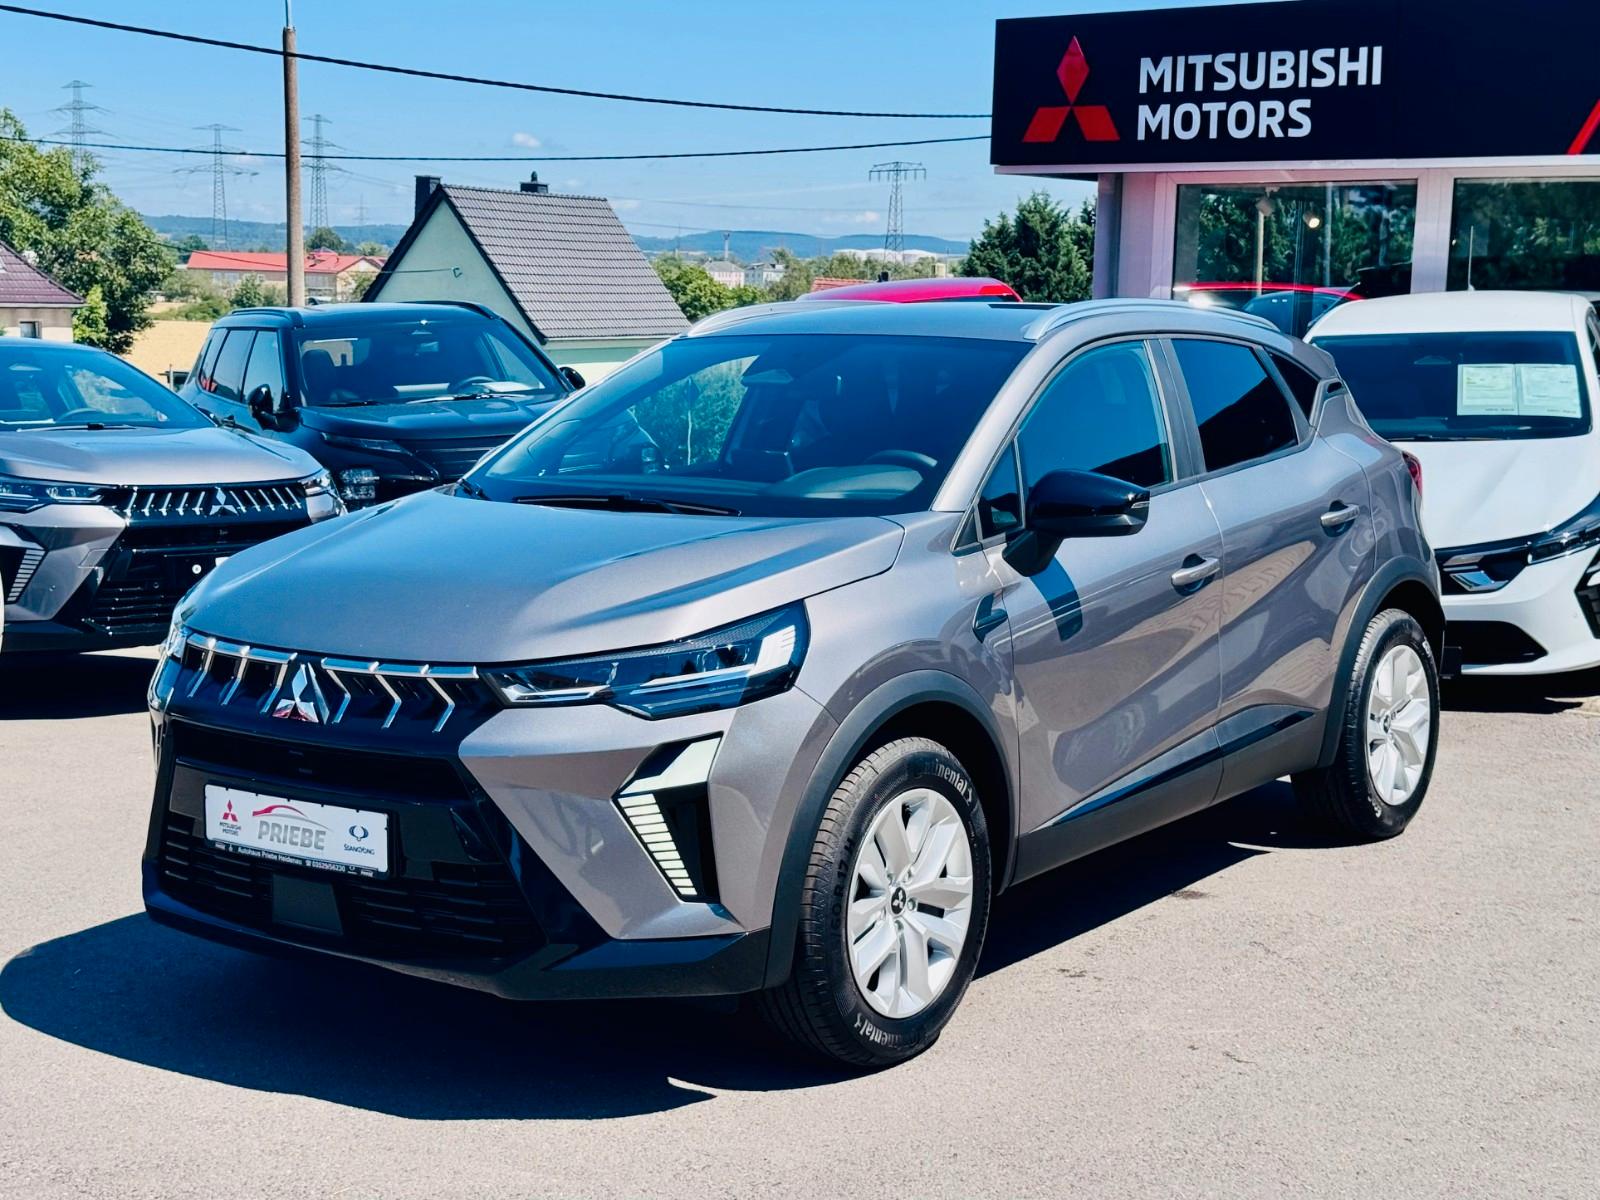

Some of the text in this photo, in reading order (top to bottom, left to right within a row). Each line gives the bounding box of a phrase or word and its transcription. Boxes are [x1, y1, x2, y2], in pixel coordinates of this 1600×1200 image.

[1138, 46, 1383, 94] MITSUBISHI
[1137, 99, 1312, 141] MOTORS
[258, 820, 327, 850] PRIEBE
